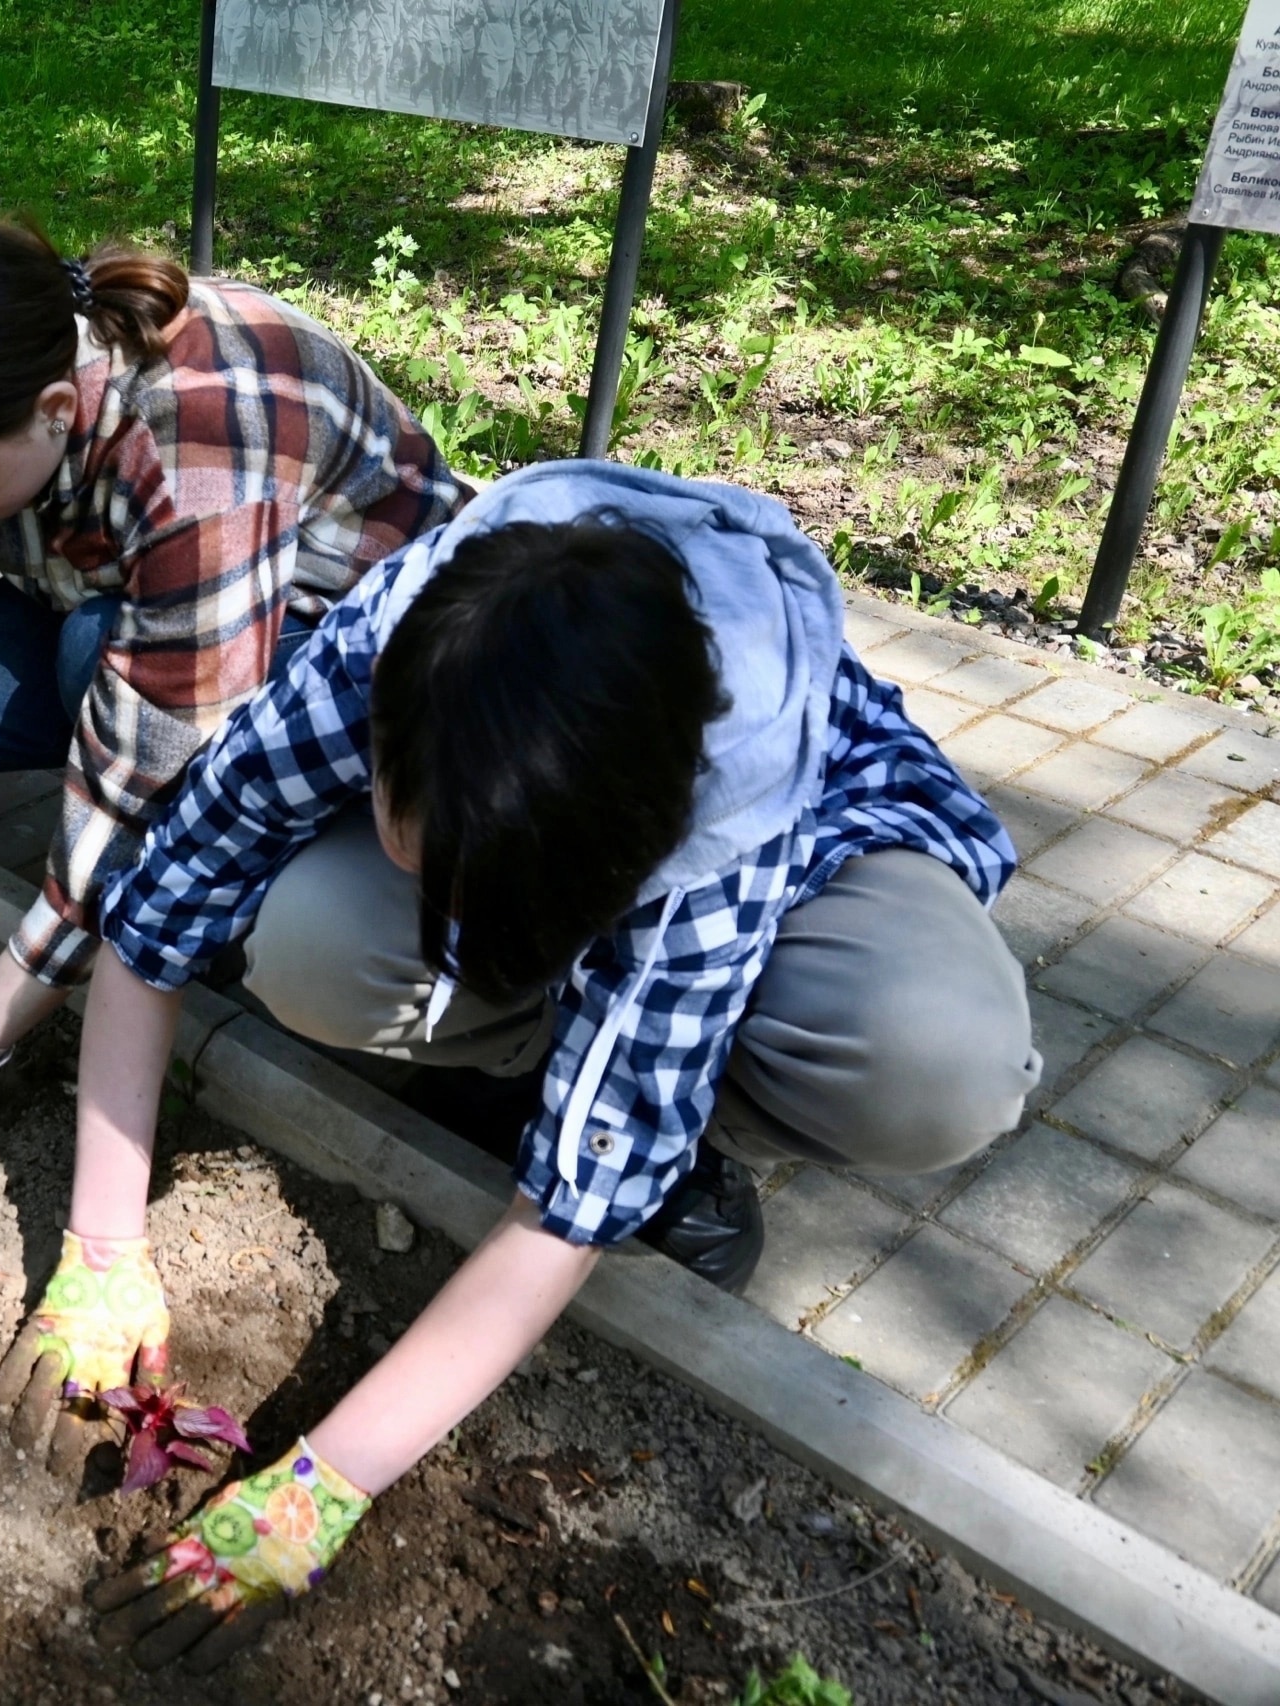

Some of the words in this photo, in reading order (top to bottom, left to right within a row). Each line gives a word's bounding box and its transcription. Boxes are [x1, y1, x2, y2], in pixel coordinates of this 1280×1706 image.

[1262, 66, 1280, 78] Бо
[1243, 80, 1280, 93] Андре
[1232, 120, 1280, 133] Блинова
[1228, 132, 1265, 145] Рыбин
[1231, 172, 1280, 187] Велико
[1213, 184, 1267, 198] Савельев
